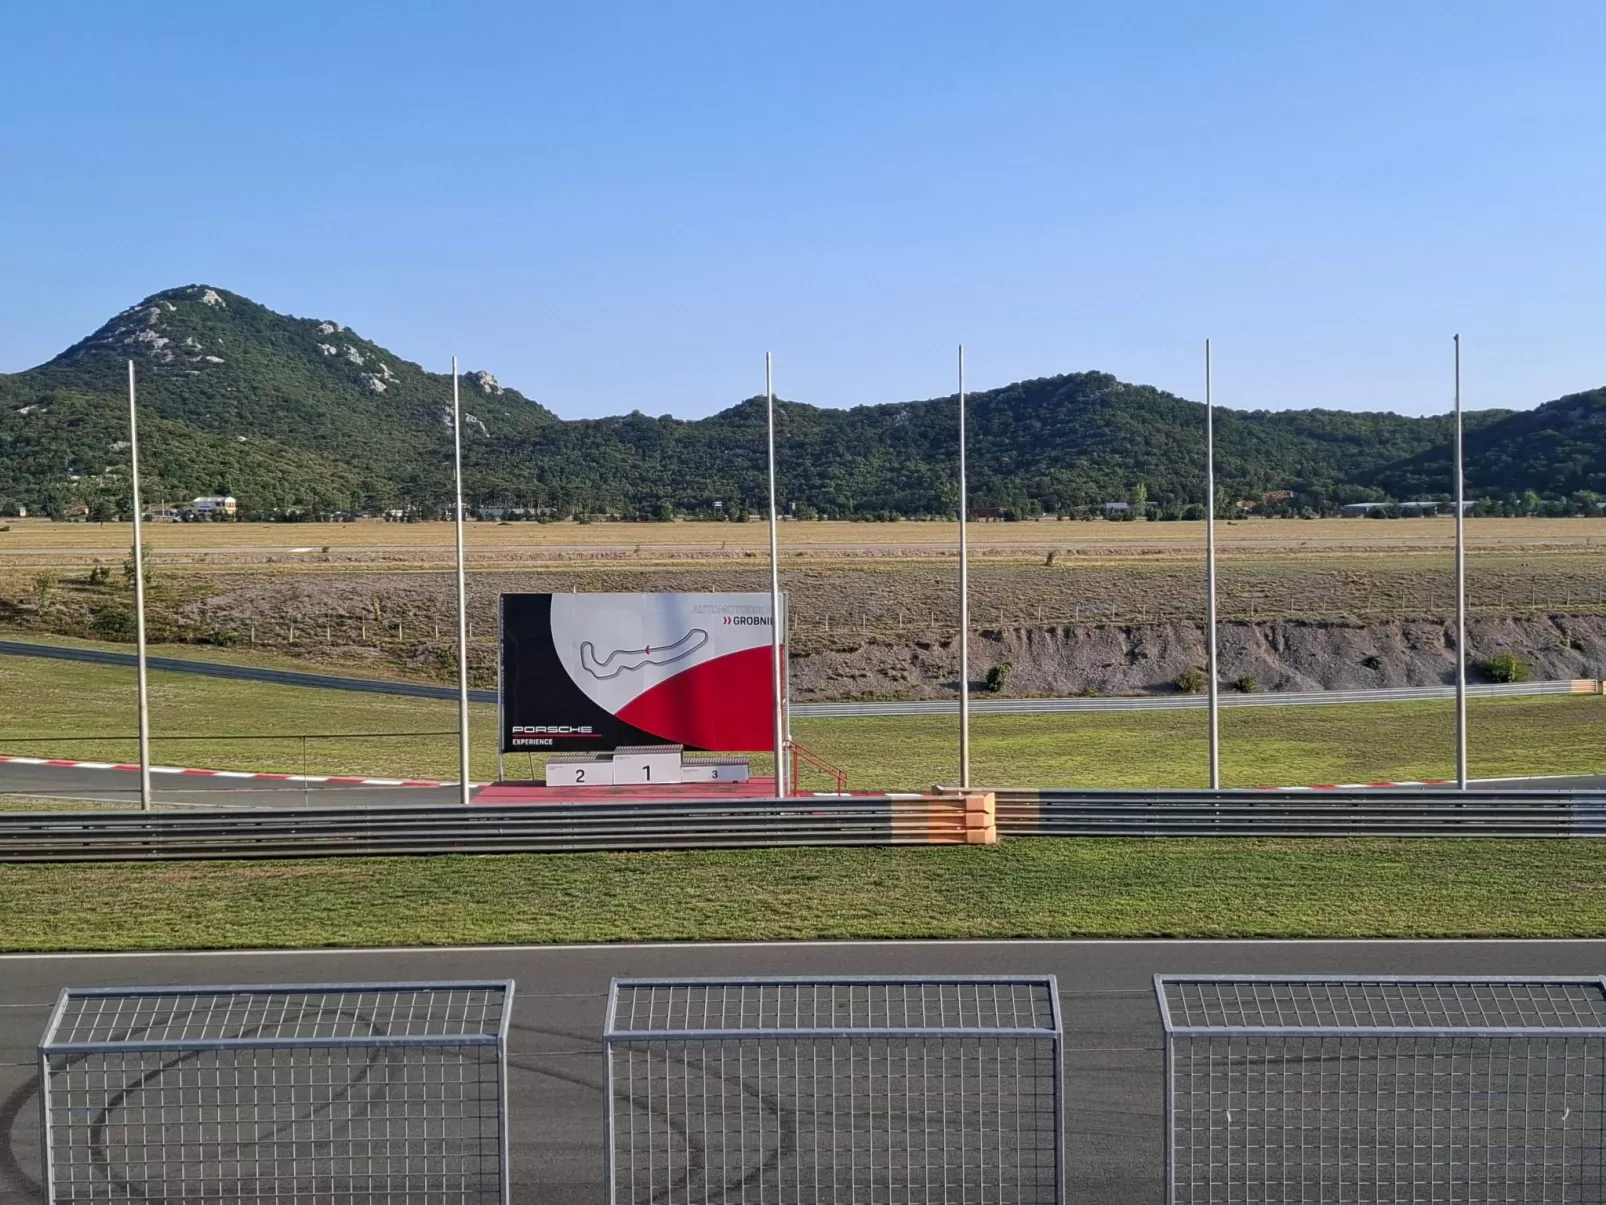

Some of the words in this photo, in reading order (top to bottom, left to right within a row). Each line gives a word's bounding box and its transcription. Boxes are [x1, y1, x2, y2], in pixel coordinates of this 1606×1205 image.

[512, 725, 593, 734] PORSCHE
[512, 738, 553, 746] EXPERIENCE
[575, 769, 585, 783] 2
[642, 765, 651, 781] 1
[711, 770, 718, 779] 3
